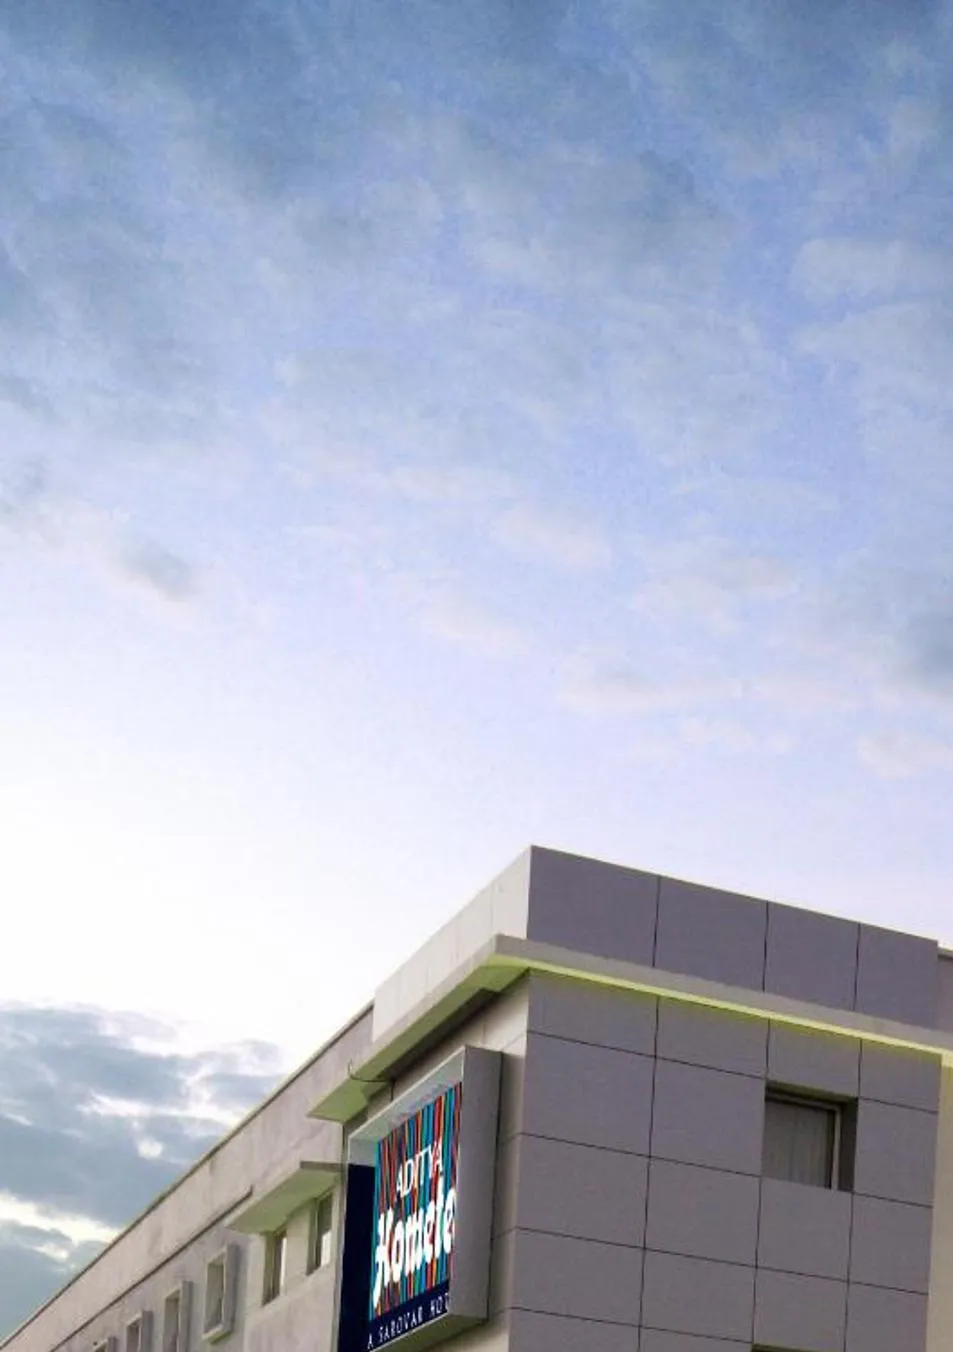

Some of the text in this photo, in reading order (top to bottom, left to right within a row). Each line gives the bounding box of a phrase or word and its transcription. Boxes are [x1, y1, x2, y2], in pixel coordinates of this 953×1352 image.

[396, 1140, 443, 1199] ADITYA
[373, 1172, 457, 1309] Homete
[367, 1293, 449, 1350] A SAROVAR HOT
